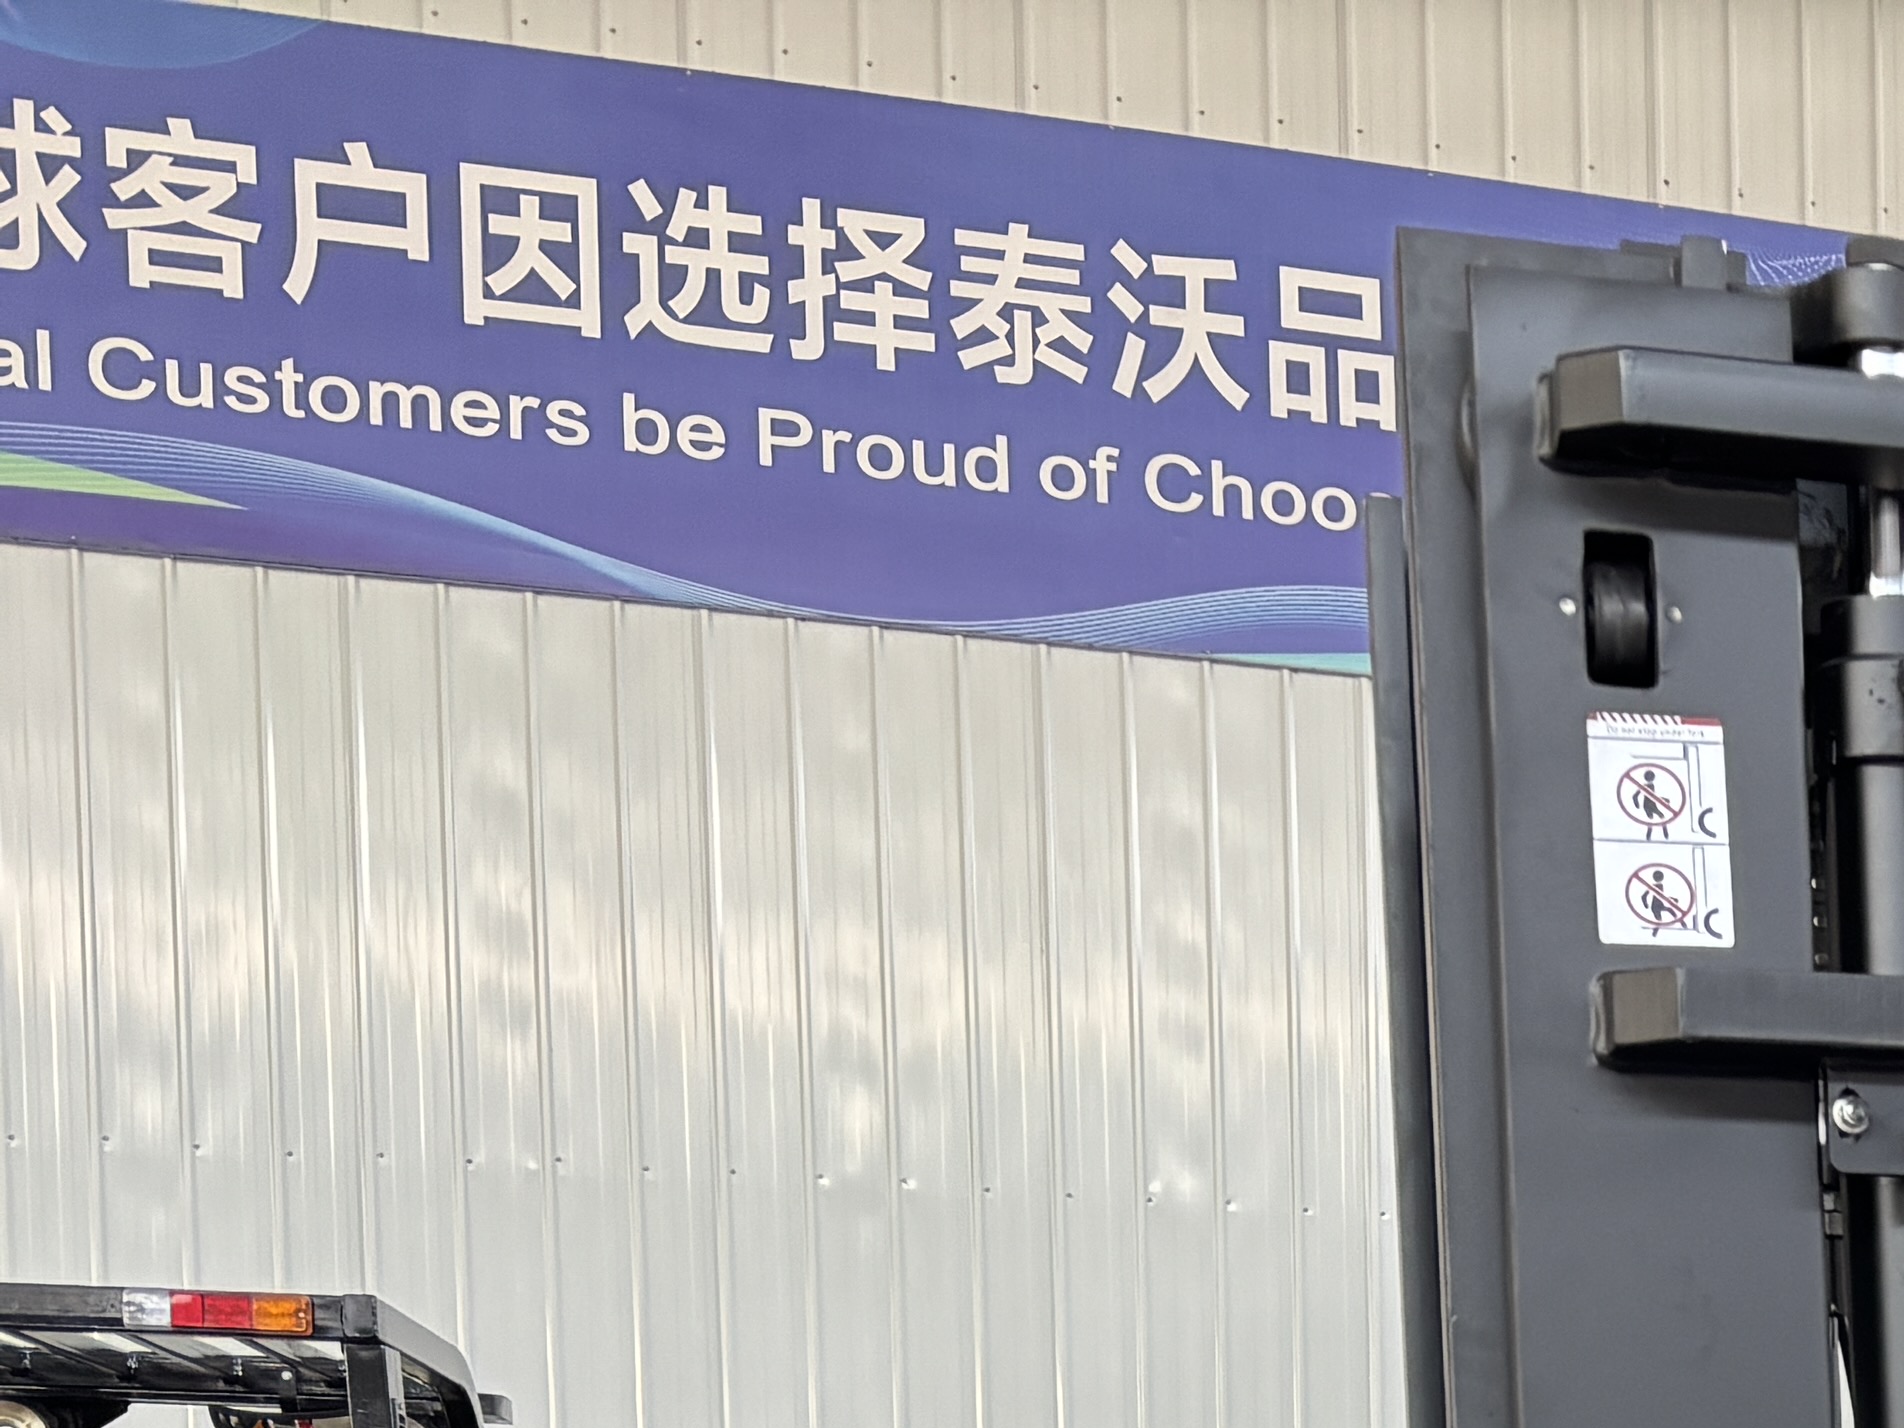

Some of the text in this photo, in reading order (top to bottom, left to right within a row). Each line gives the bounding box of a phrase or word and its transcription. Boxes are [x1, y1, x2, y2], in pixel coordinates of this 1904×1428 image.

[0, 98, 1396, 432] 球客户因选择泰沃品
[88, 337, 589, 445] Customers
[623, 392, 725, 460] be
[758, 407, 1009, 493] Proud
[1039, 446, 1119, 504] of
[1145, 454, 1356, 530] Choo
